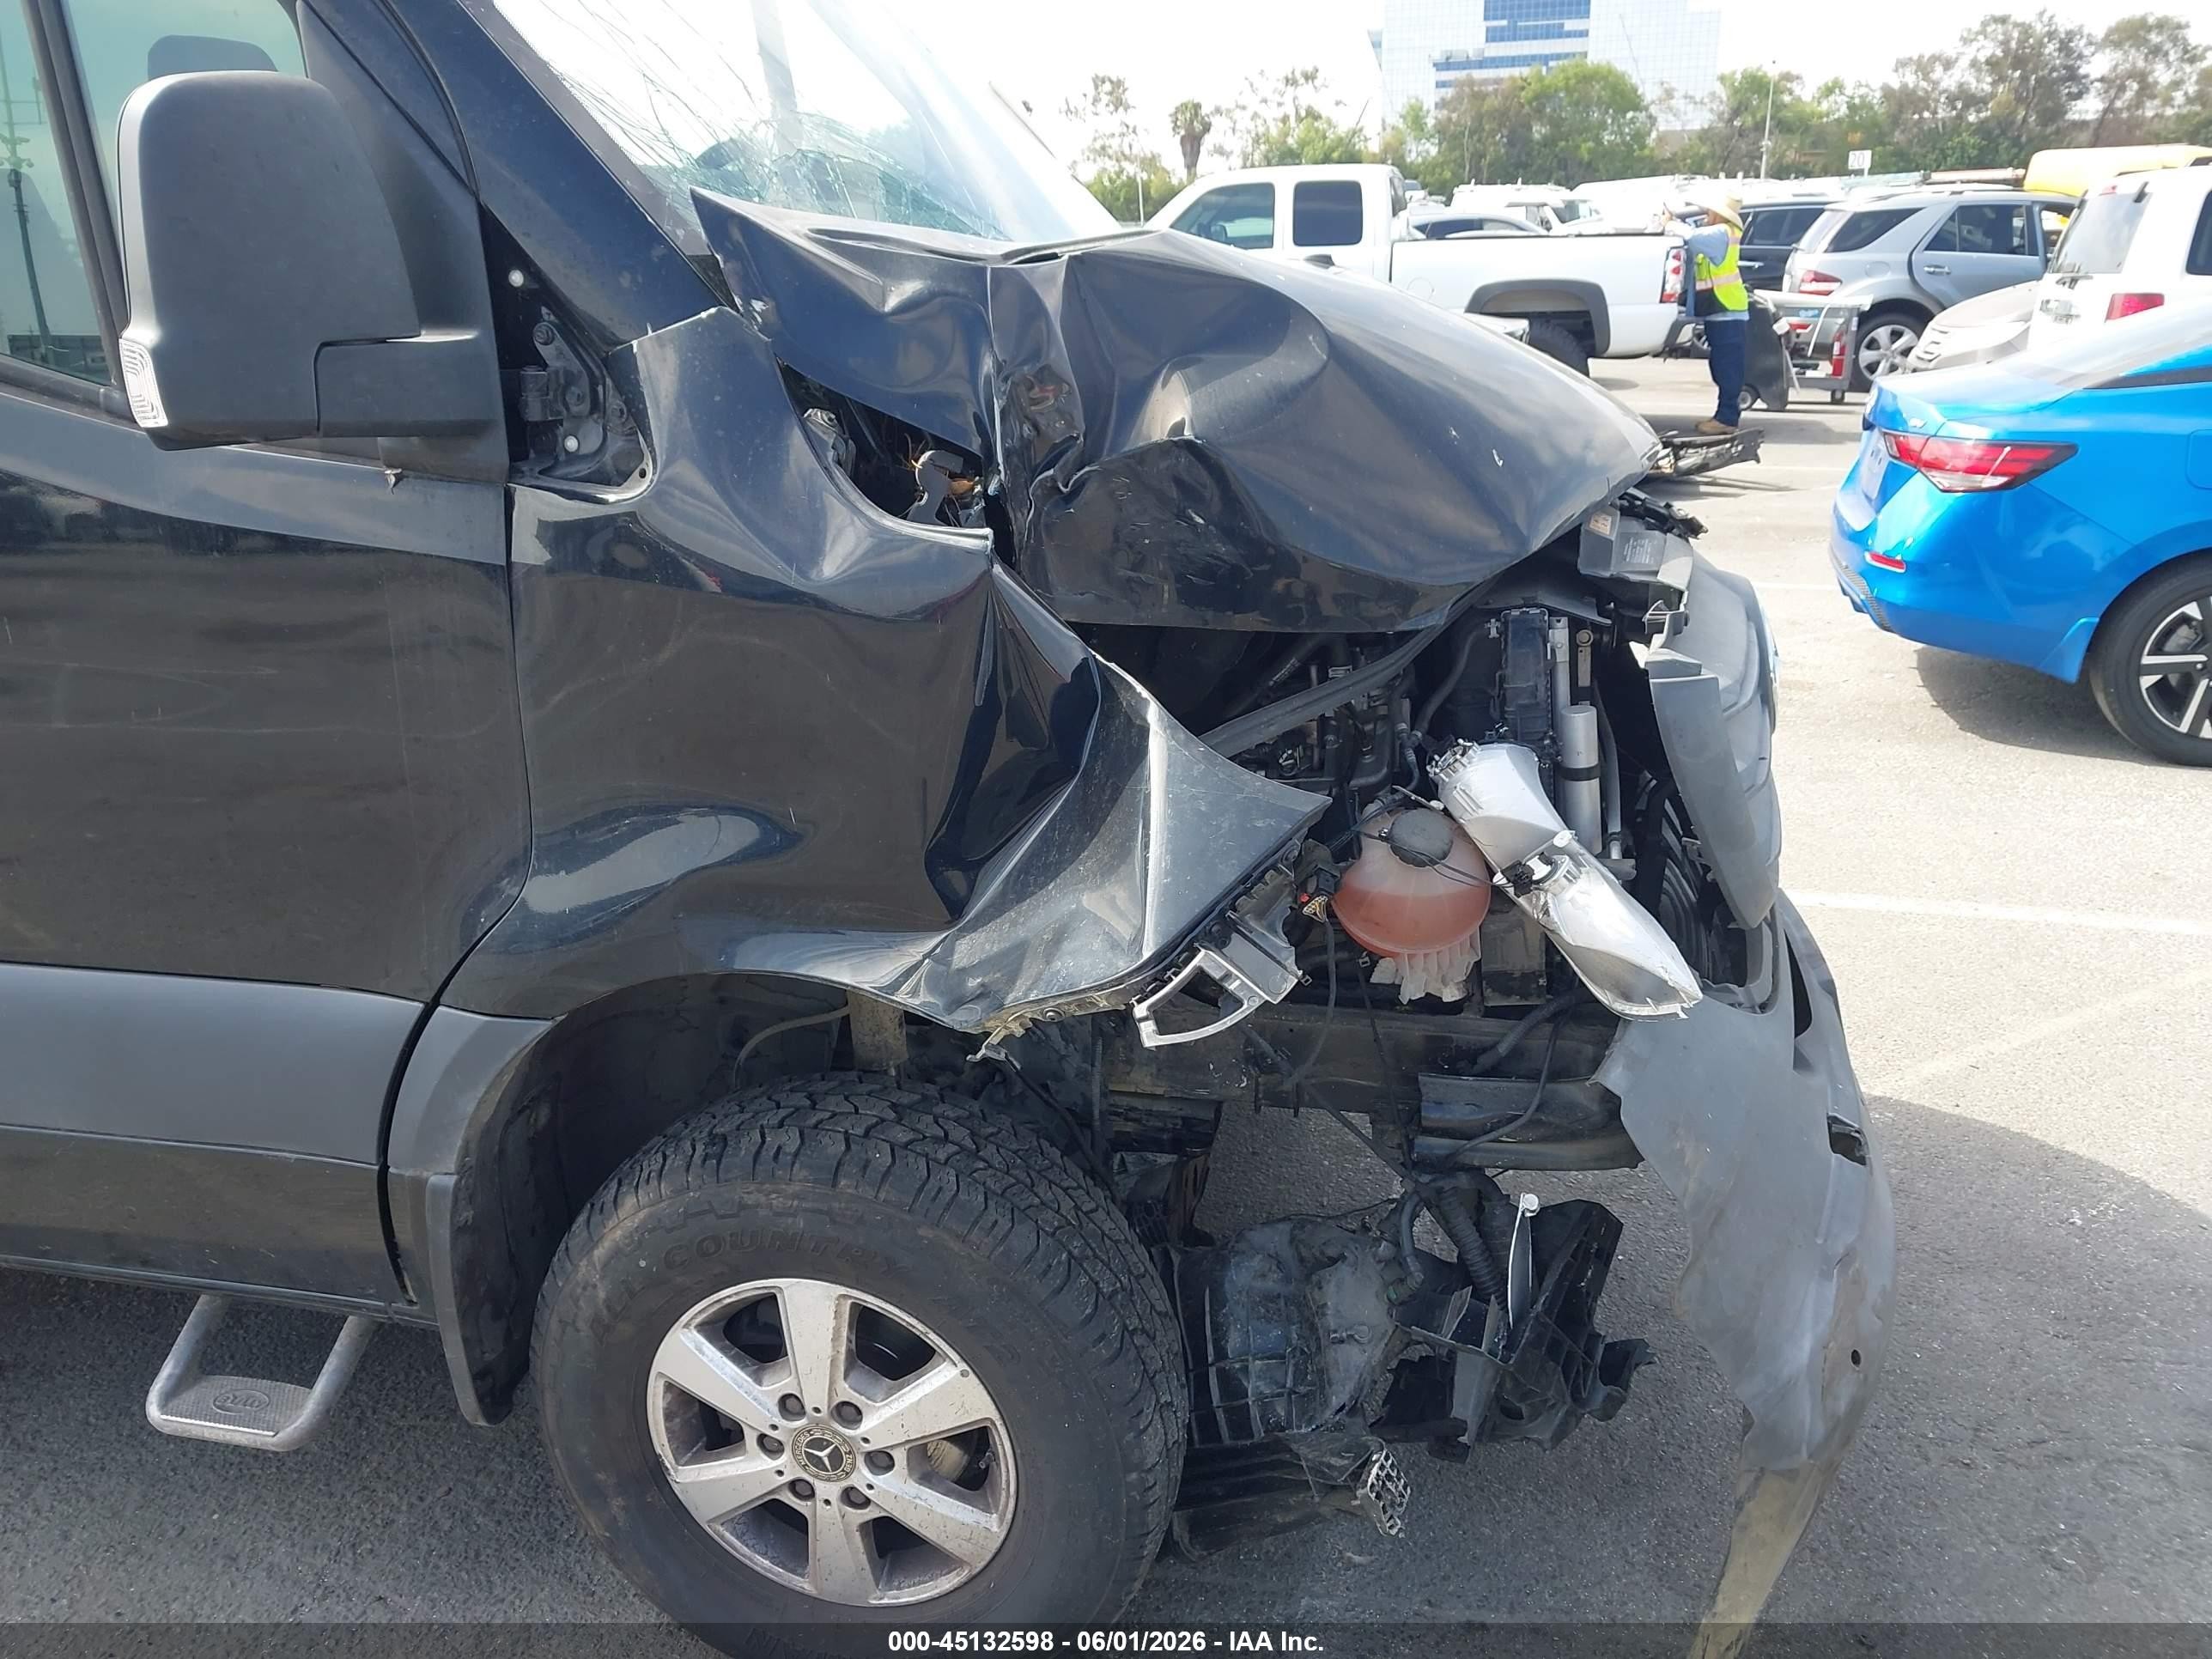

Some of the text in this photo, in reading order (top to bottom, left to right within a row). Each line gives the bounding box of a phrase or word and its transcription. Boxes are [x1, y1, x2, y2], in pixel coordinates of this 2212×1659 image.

[1850, 152, 1865, 167] 20
[662, 1227, 912, 1279] COUNTRY
[794, 1431, 854, 1473] MERCEDES BENZ
